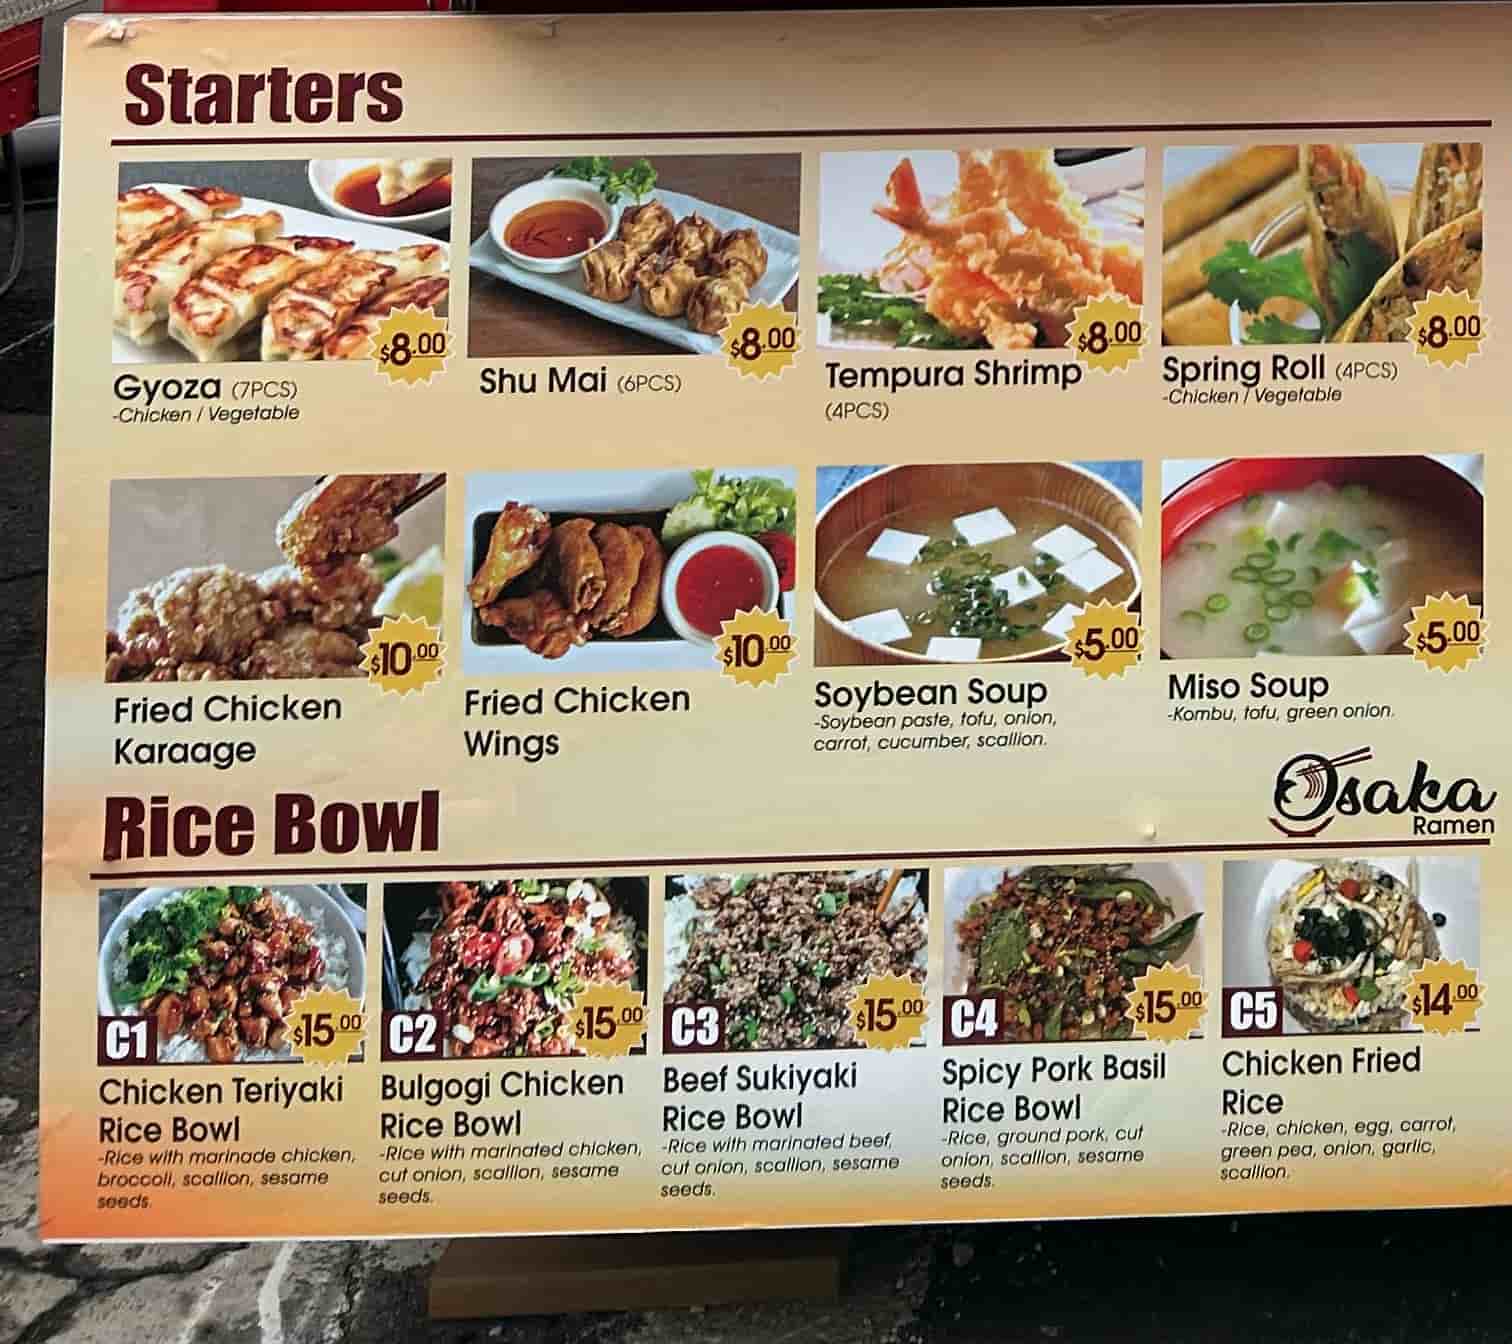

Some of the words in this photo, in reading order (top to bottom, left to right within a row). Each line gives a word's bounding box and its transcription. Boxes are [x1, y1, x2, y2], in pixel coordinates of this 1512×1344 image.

[124, 63, 404, 127] Starters
[479, 367, 537, 395] Shu
[548, 365, 607, 393] Mai
[616, 374, 682, 395] (6PCS)
[825, 362, 964, 394] Tempura
[974, 358, 1083, 391] Shrimp
[1163, 356, 1260, 386] Spring
[1271, 353, 1325, 381] Roll
[1335, 360, 1398, 382] (4PCS)
[113, 373, 222, 407] Gyoza
[231, 380, 298, 401] (7PCS)
[196, 406, 205, 423] /
[208, 404, 300, 425] Vegetable
[824, 401, 890, 422] (4PCS)
[465, 687, 543, 717] Fried
[554, 685, 690, 714] Chicken
[814, 679, 957, 713] Soybean
[967, 677, 1048, 710] Soup
[1168, 673, 1241, 700] Miso
[1249, 671, 1330, 704] Soup
[114, 695, 193, 724] Fried
[203, 693, 342, 722] Chicken
[900, 711, 954, 731] paste,
[960, 710, 997, 728] tofu,
[1003, 710, 1057, 727] onion,
[1244, 704, 1280, 721] tofu,
[1286, 706, 1339, 724] green
[114, 737, 257, 771] Karaage
[463, 729, 560, 763] Wings
[813, 735, 871, 753] carrot,
[877, 733, 971, 750] cucumber,
[976, 731, 1047, 748] scallion.
[1271, 749, 1496, 823] Osaka
[102, 795, 255, 864] Rice
[273, 789, 441, 856] Bowl
[1413, 815, 1495, 836] Ramen
[105, 1021, 148, 1059] C1
[389, 1014, 436, 1054] C2
[942, 1057, 1022, 1092] Spicy
[1031, 1054, 1093, 1083] Pork
[1103, 1051, 1166, 1081] Basil
[1222, 1048, 1343, 1078] Chicken
[1352, 1045, 1421, 1074] Fried
[99, 1077, 223, 1106] Chicken
[231, 1074, 343, 1110] Teriyaki
[381, 1071, 491, 1107] Bulgogi
[500, 1069, 624, 1098] Chicken
[663, 1064, 729, 1094] Beef
[735, 1061, 857, 1097] Sukiyaki
[663, 1104, 726, 1132] Rice
[735, 1101, 803, 1130] Bowl
[943, 1096, 1005, 1124] Rice
[1015, 1093, 1081, 1122] Bowl
[1222, 1088, 1284, 1116] Rice
[99, 1116, 162, 1144] Rice
[172, 1115, 240, 1143] Bowl
[380, 1112, 444, 1140] Rice
[454, 1109, 521, 1138] Bowl
[149, 1149, 184, 1166] with
[188, 1147, 276, 1165] marinade
[280, 1147, 356, 1164] chicken,
